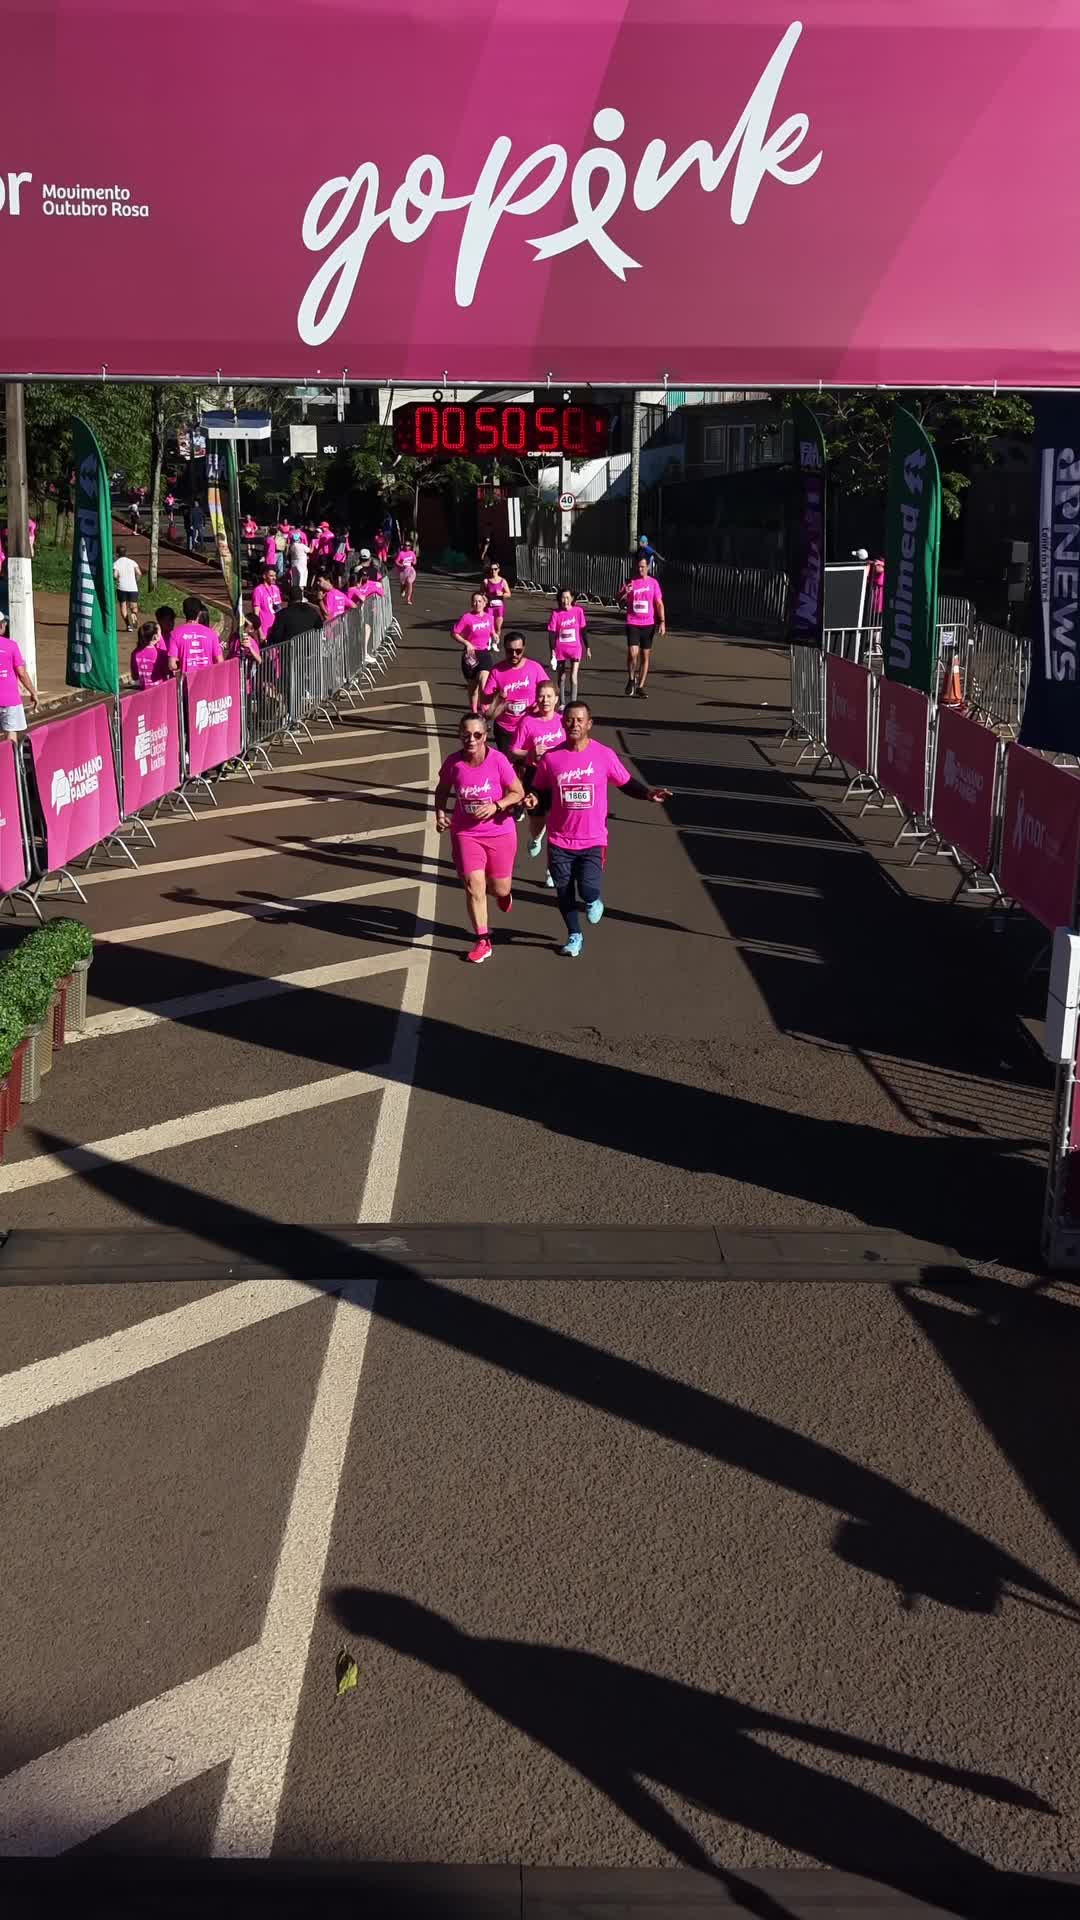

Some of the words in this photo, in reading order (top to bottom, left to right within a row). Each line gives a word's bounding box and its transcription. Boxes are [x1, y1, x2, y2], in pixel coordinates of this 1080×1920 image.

[0, 171, 32, 215] r
[42, 183, 130, 200] Movimento
[298, 20, 823, 346] gopink
[42, 200, 107, 216] Outubro
[111, 202, 149, 217] Rosa
[561, 496, 573, 504] 40
[888, 503, 920, 670] Unimed
[68, 754, 103, 787] PALHANO
[568, 792, 588, 800] 1866
